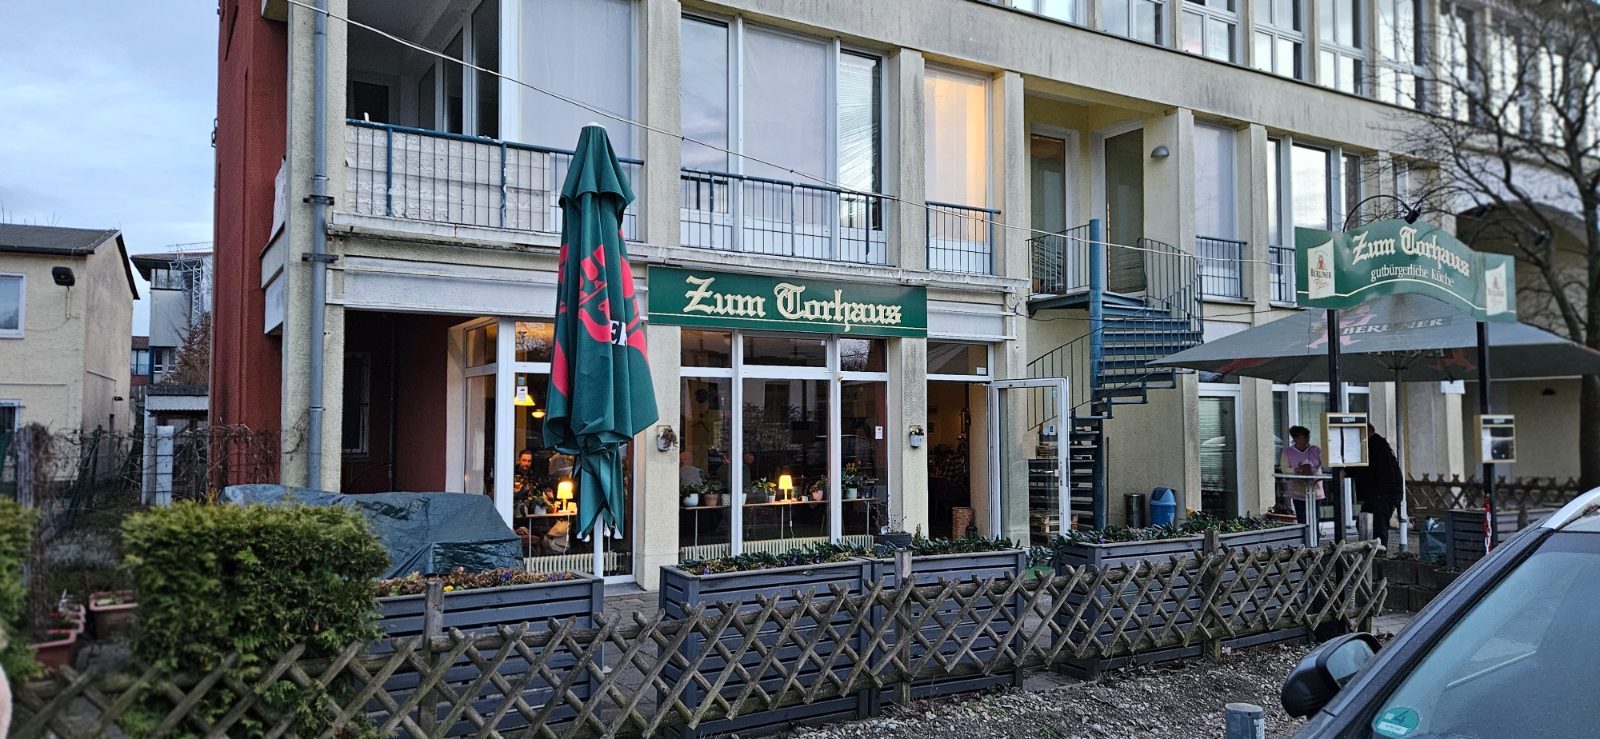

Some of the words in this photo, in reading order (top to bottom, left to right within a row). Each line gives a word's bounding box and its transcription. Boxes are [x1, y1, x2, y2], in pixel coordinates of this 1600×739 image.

[1352, 230, 1396, 266] Zum
[1400, 226, 1470, 277] Torhaus
[1370, 263, 1429, 282] gutbürgerliche
[1431, 268, 1455, 288] Küche
[683, 275, 766, 318] Zum
[774, 282, 902, 332] Torhaus
[1342, 319, 1443, 335] BERLNER
